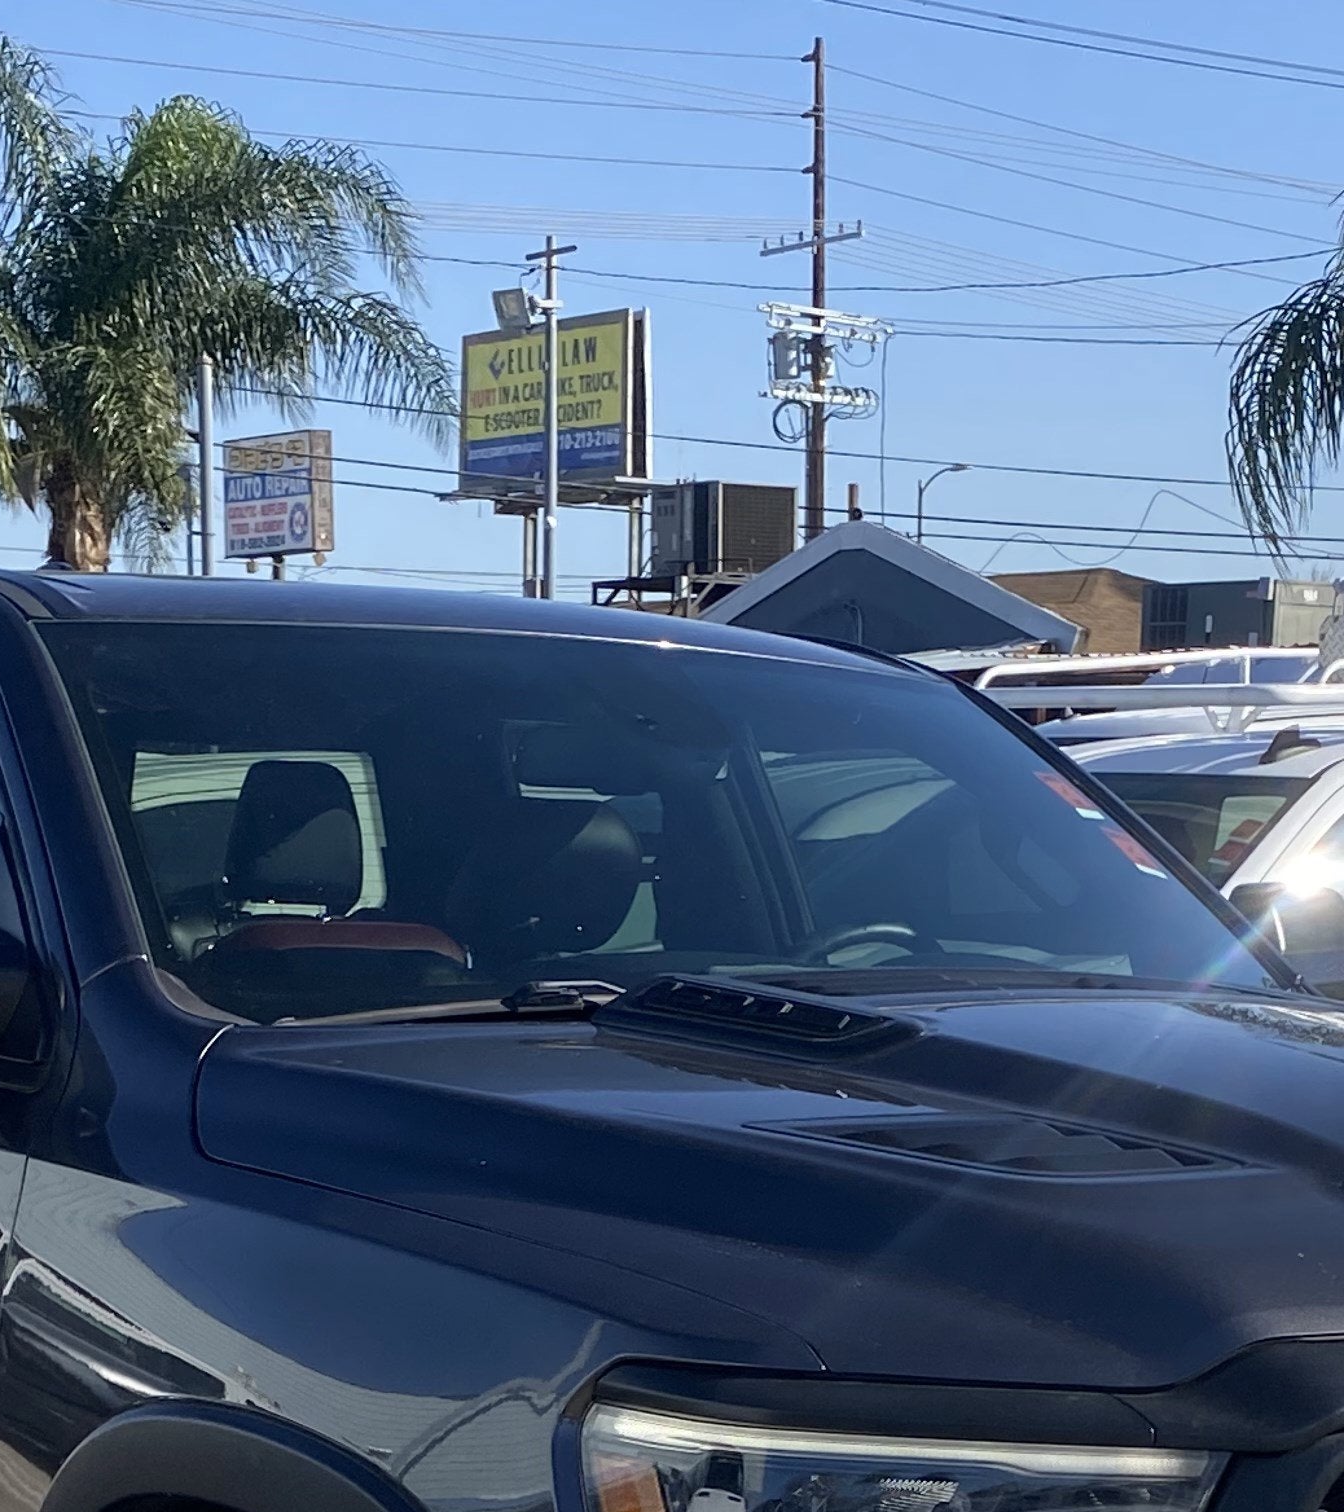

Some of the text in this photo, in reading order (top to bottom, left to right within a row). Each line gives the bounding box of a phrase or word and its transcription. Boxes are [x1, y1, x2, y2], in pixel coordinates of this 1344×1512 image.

[508, 337, 598, 375] ELLI LAW
[555, 376, 577, 398] IKE,
[579, 370, 619, 394] TRUCK,
[227, 471, 310, 502] AUTO REPAIR
